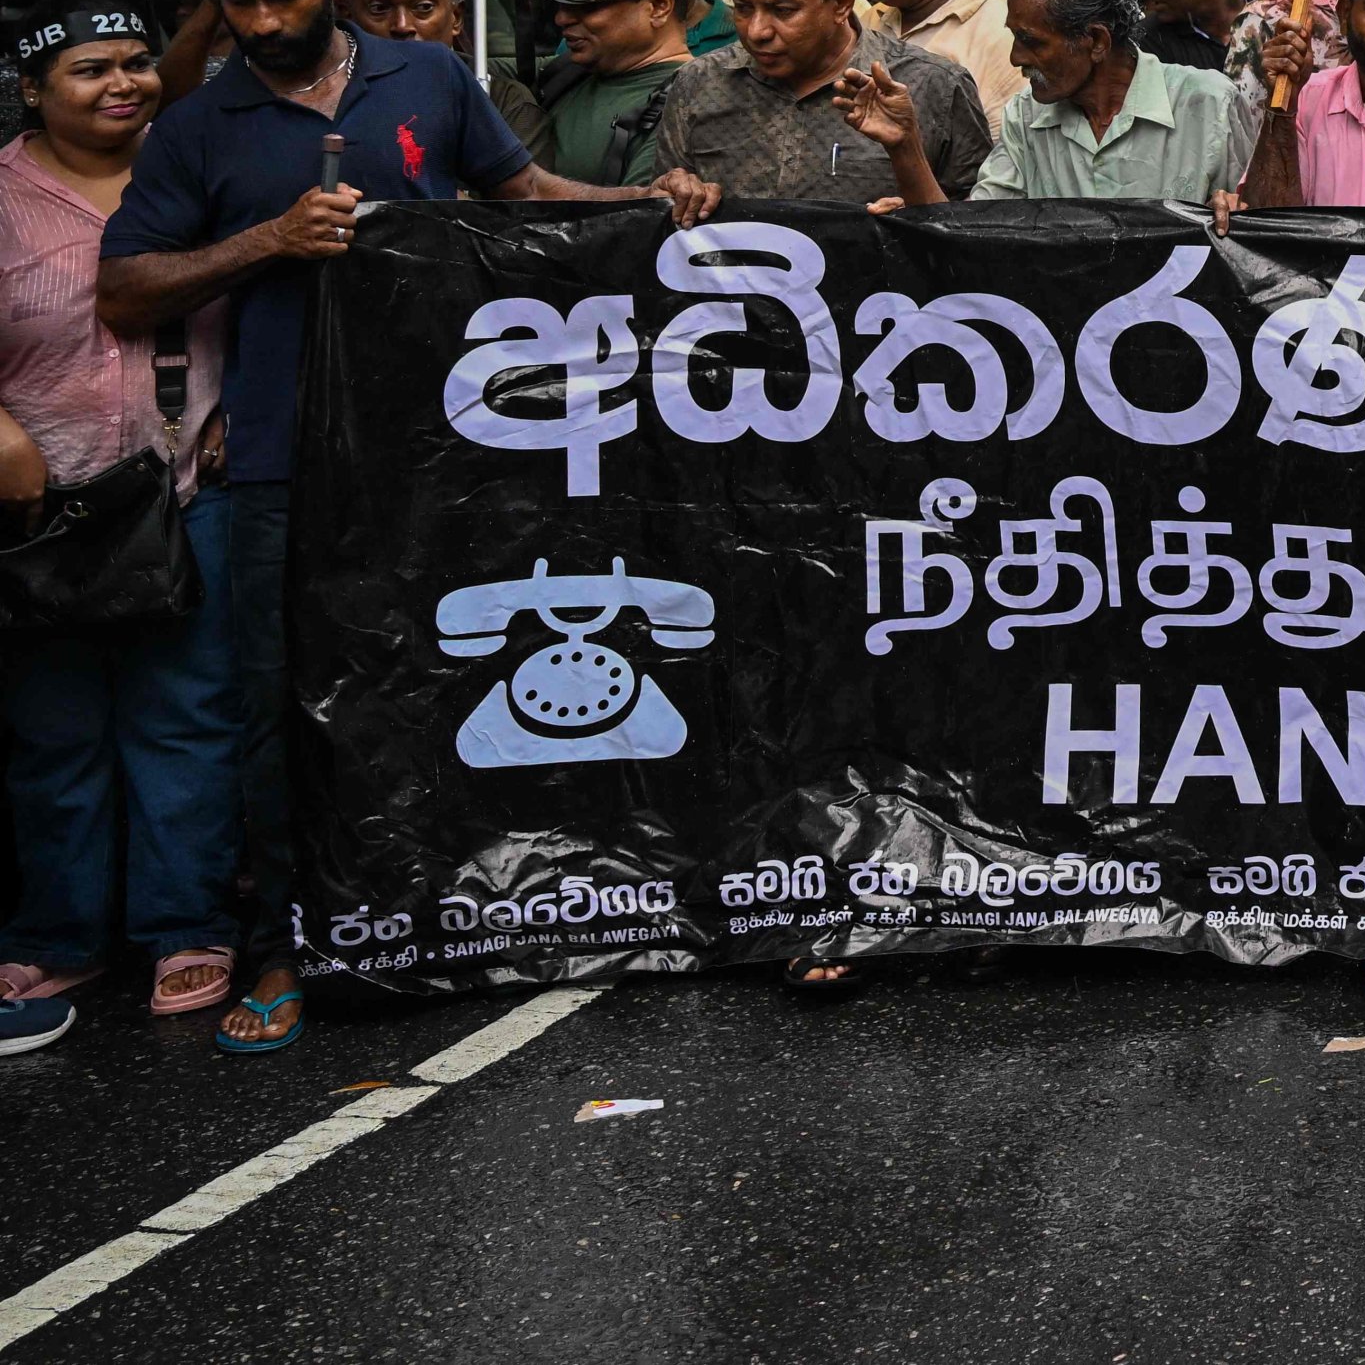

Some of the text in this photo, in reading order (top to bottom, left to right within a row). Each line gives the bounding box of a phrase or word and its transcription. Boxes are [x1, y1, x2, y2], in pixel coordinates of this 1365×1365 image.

[18, 23, 66, 59] SJB
[91, 12, 129, 34] 22
[718, 854, 826, 909] සමගි
[848, 850, 917, 896] ජන
[1206, 853, 1316, 897] සමගි
[863, 905, 917, 926] சக்தி
[940, 910, 1000, 925] SAMAGI
[1004, 911, 1048, 927] JANA
[1053, 906, 1160, 925] BALAWEGAYA
[1283, 908, 1347, 930] மக்கள்
[444, 934, 511, 959] SAMAGI
[516, 934, 562, 947] JANA
[568, 924, 680, 944] BALAWEGAYA
